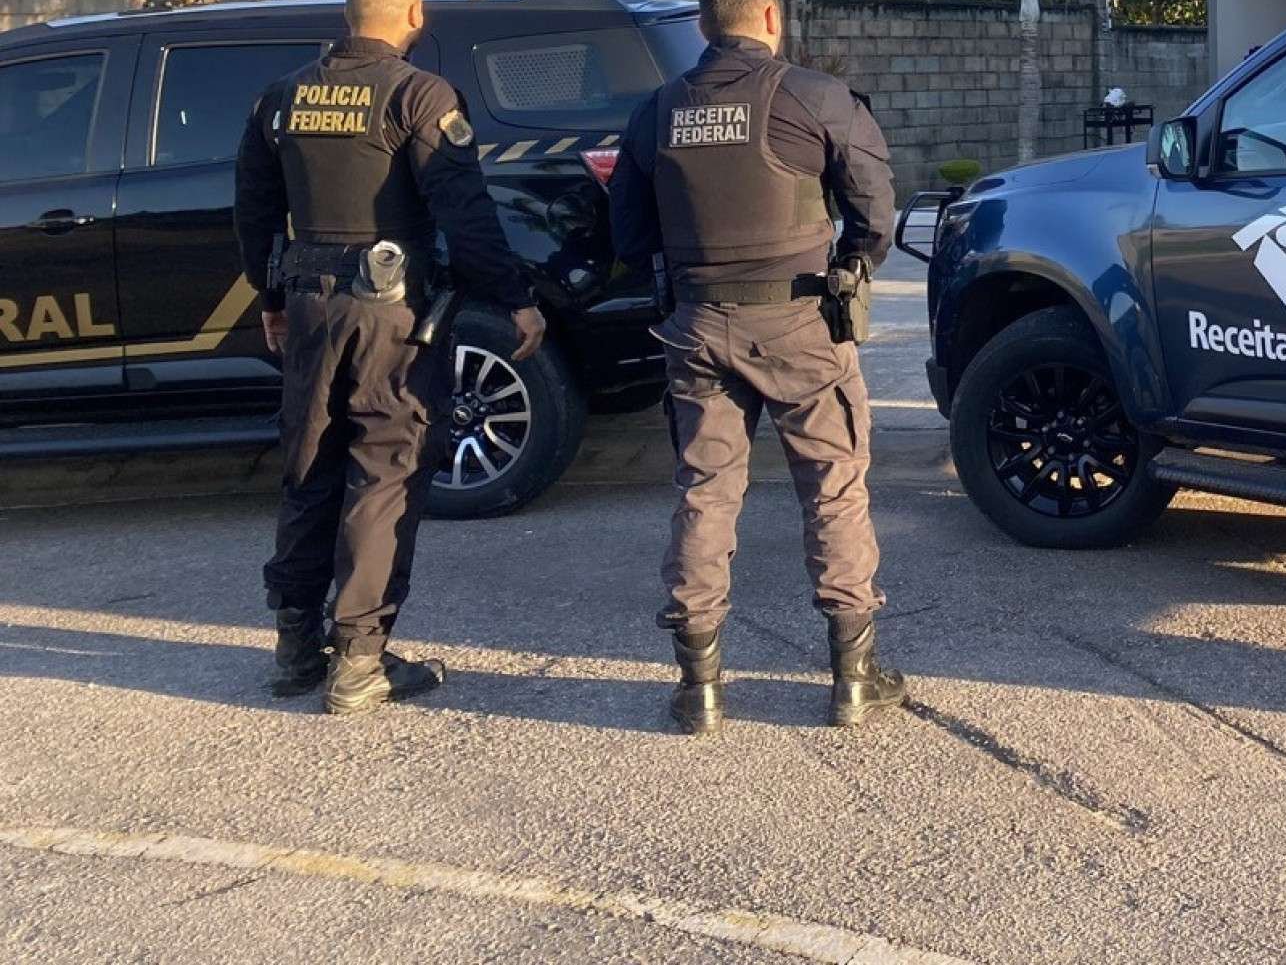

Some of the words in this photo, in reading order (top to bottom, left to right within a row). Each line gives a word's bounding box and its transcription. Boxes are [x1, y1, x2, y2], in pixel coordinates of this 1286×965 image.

[294, 85, 371, 105] POLICIA
[289, 110, 366, 132] FEDERAL
[673, 106, 746, 126] RECEITA
[672, 123, 745, 144] FEDERAL
